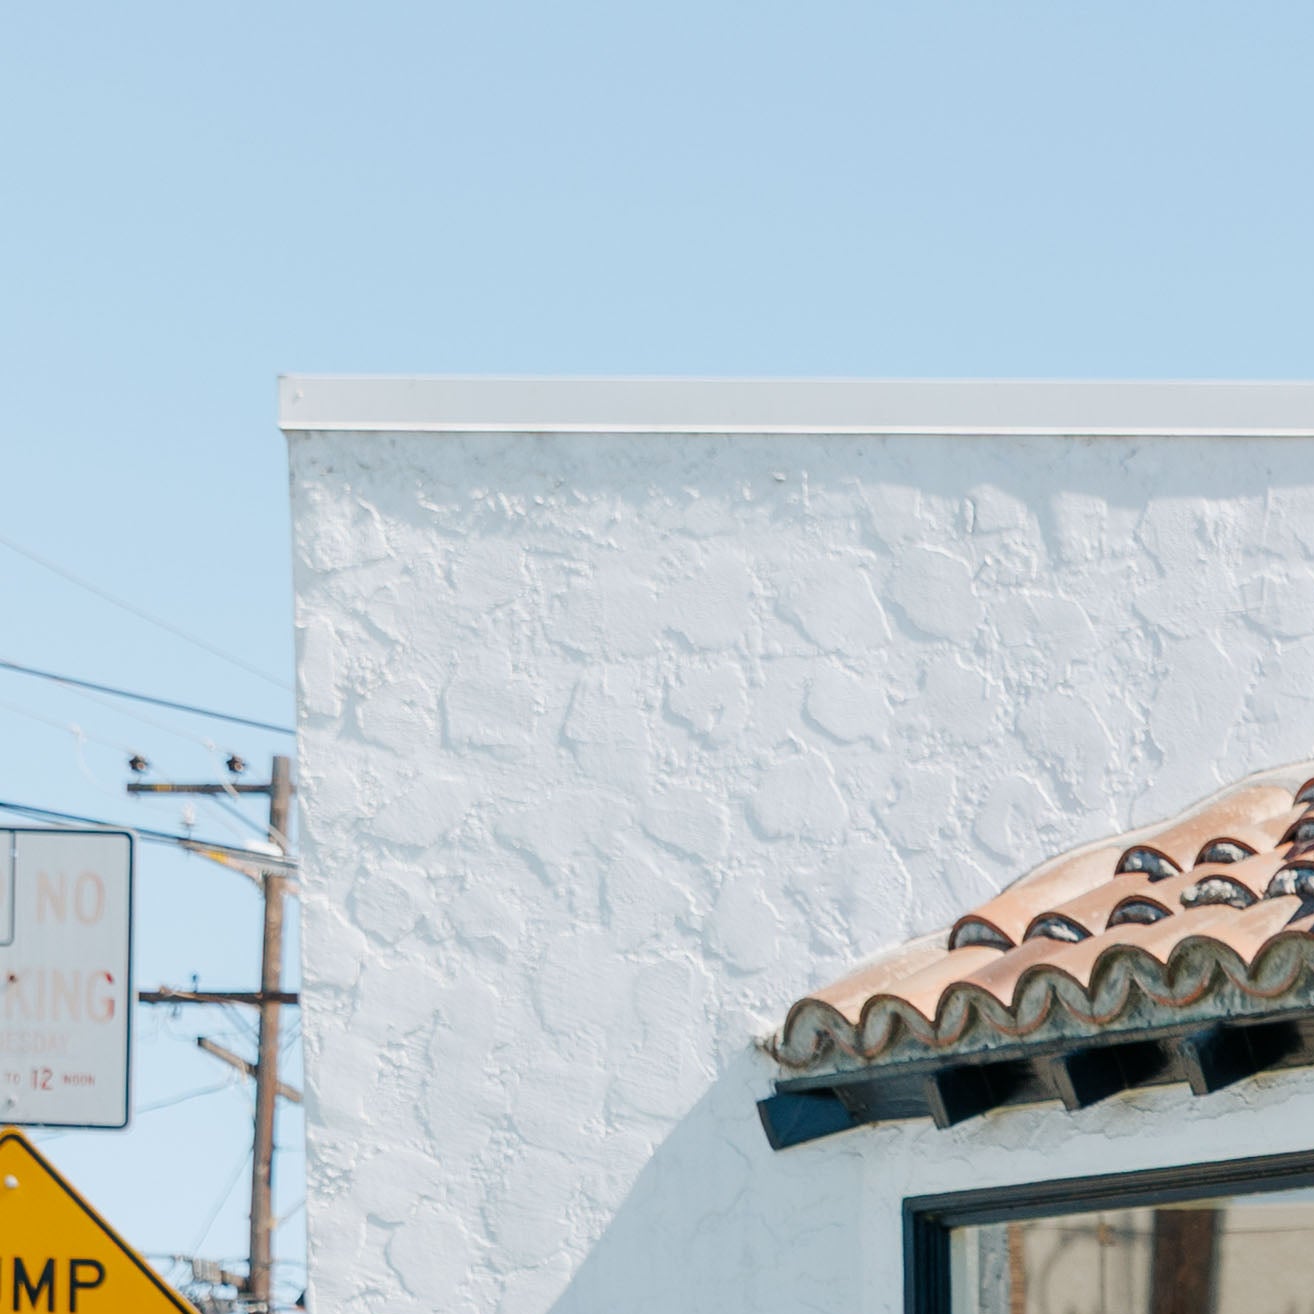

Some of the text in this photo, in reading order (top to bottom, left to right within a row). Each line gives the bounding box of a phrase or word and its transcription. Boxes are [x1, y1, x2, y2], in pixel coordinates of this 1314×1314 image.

[36, 869, 106, 926] NO
[32, 1066, 54, 1091] 12
[12, 1256, 107, 1314] MP
